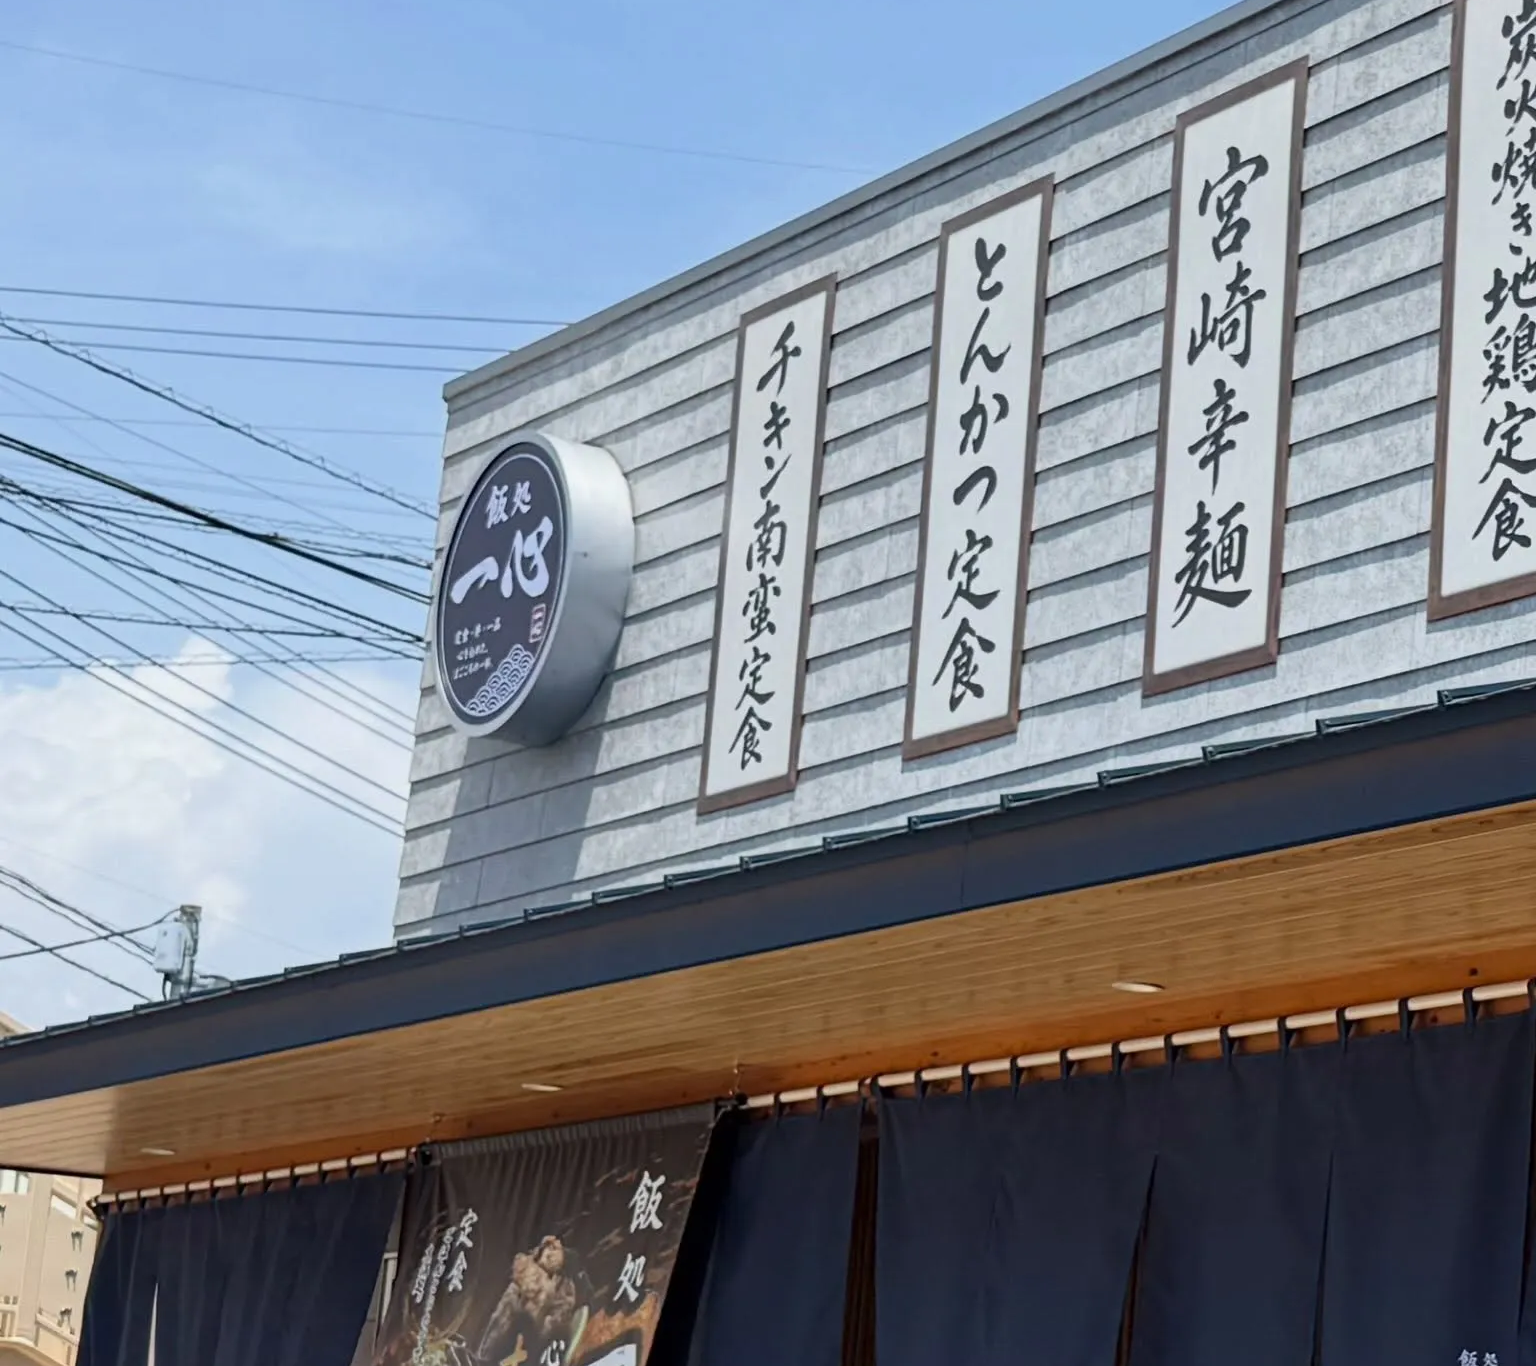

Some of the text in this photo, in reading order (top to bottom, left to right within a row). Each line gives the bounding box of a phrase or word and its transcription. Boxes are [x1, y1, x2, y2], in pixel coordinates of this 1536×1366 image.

[486, 480, 532, 529] 飯処
[932, 237, 1013, 714] とんかつ定食
[1171, 145, 1270, 630] 宮崎辛麺
[450, 515, 554, 605] 一心
[728, 320, 802, 770] チキン南蛮定食
[614, 1170, 666, 1303] 飯処
